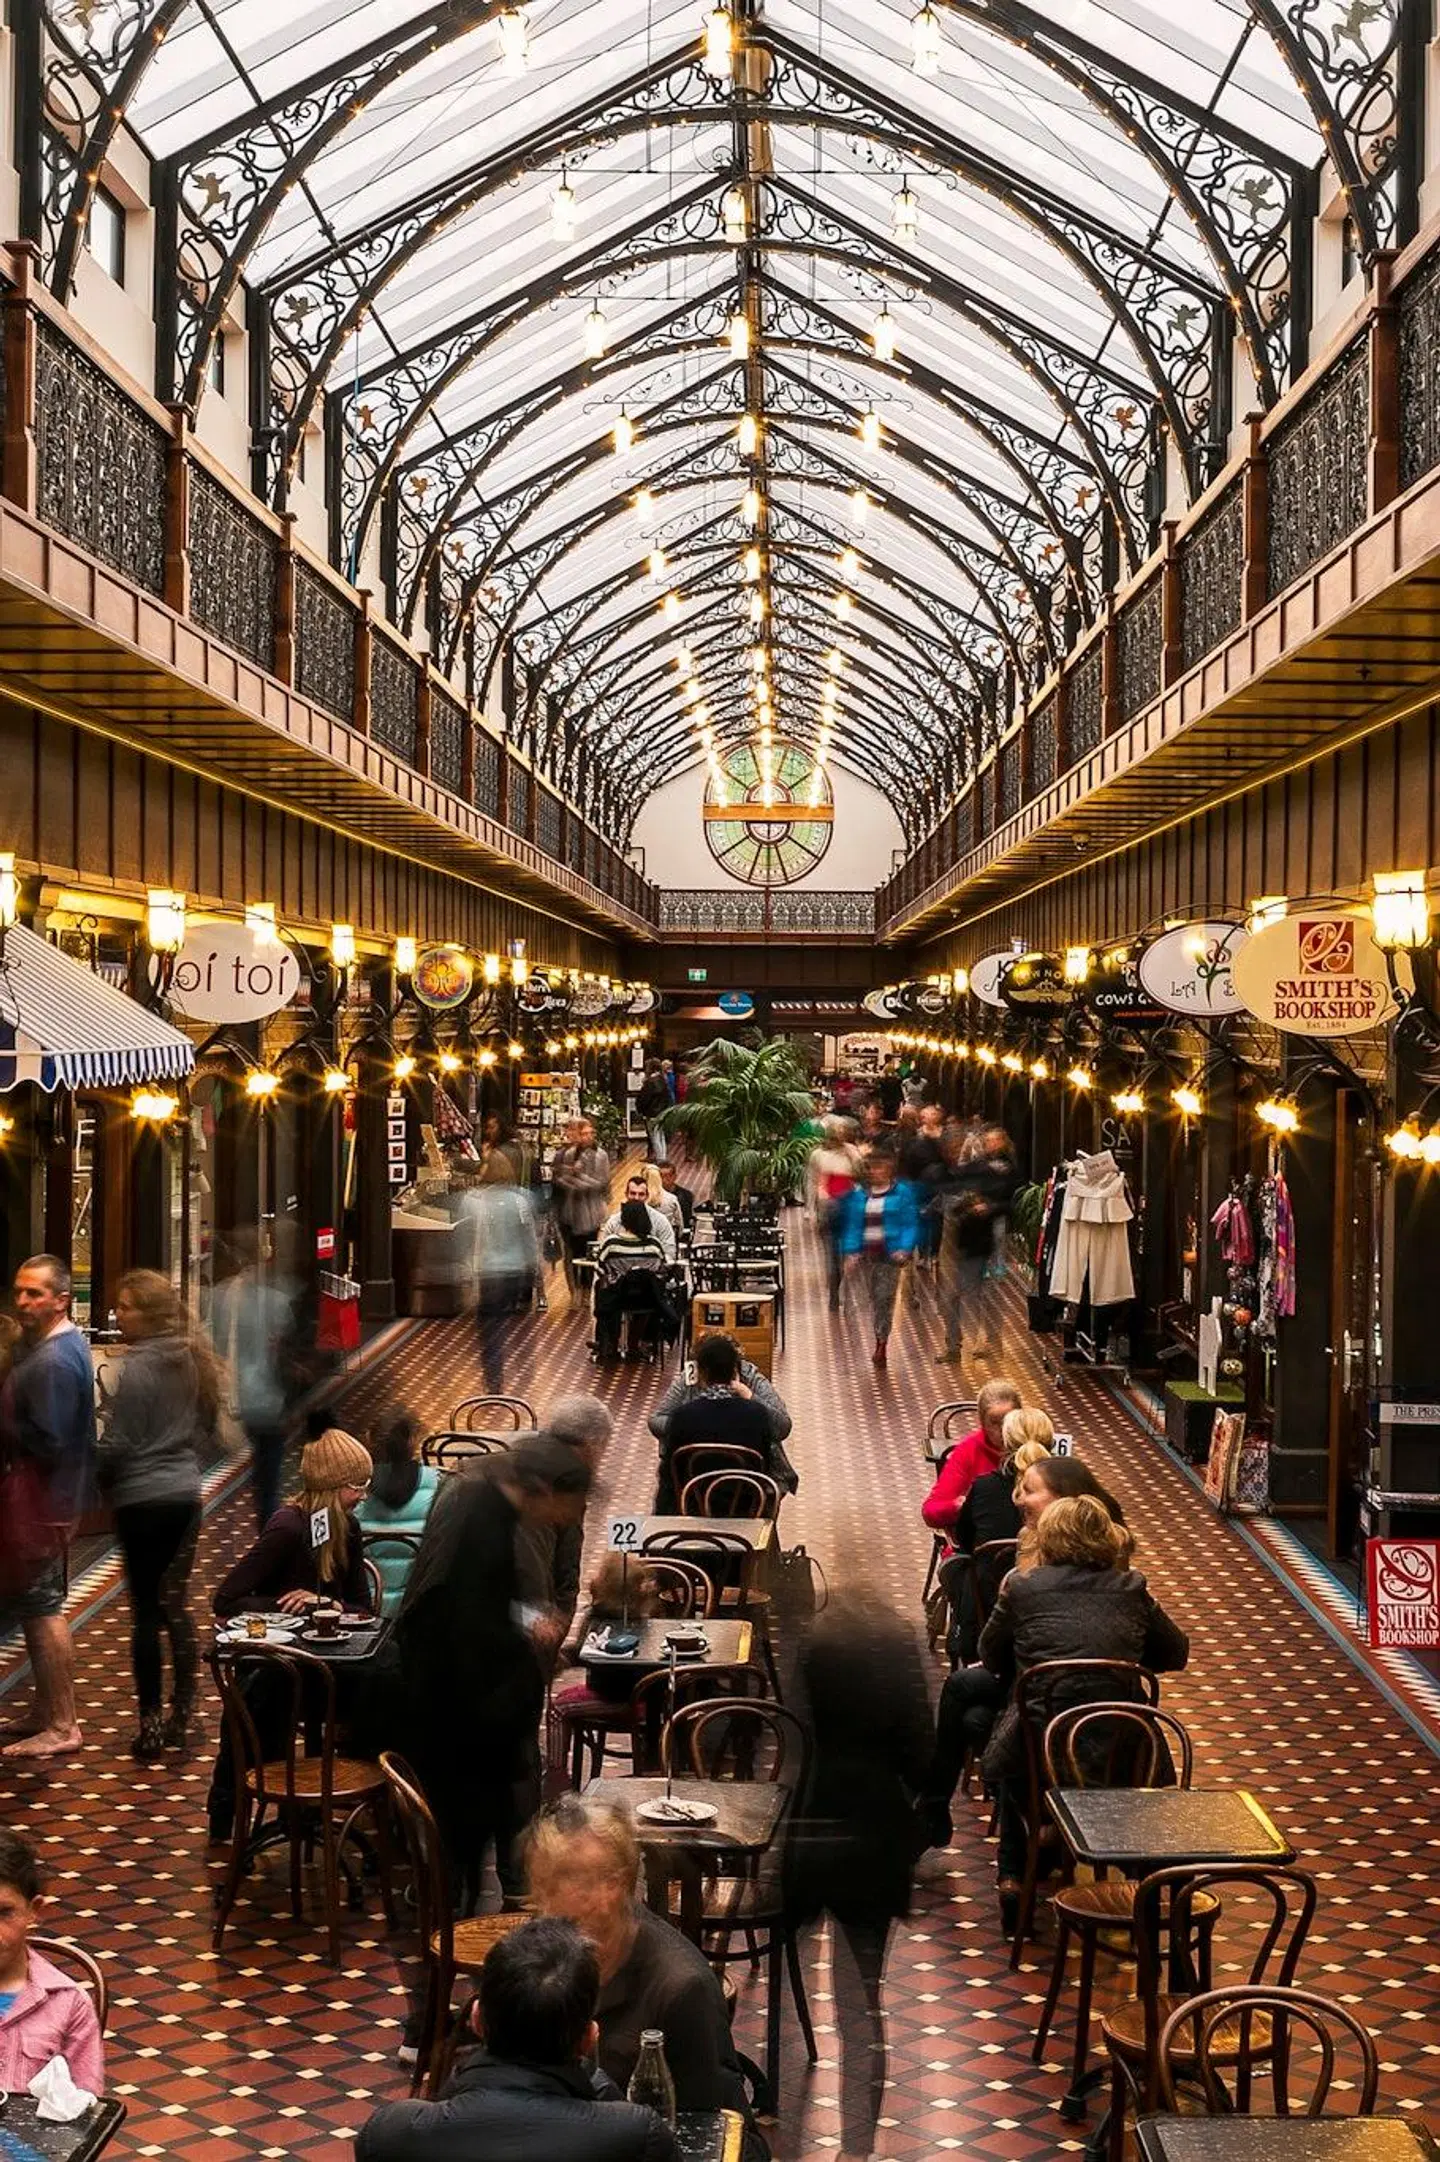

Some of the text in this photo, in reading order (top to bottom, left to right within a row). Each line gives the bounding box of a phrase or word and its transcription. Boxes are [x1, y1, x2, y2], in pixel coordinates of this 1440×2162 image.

[1275, 979, 1375, 999] SMITH'S
[1095, 992, 1134, 1006] COWS
[1274, 1001, 1377, 1020] BOOKSHOP
[1394, 1406, 1416, 1417] THE
[613, 1522, 637, 1544] 22
[1377, 1604, 1439, 1629] SMITH'S
[1378, 1629, 1439, 1645] BOOKSHOP
